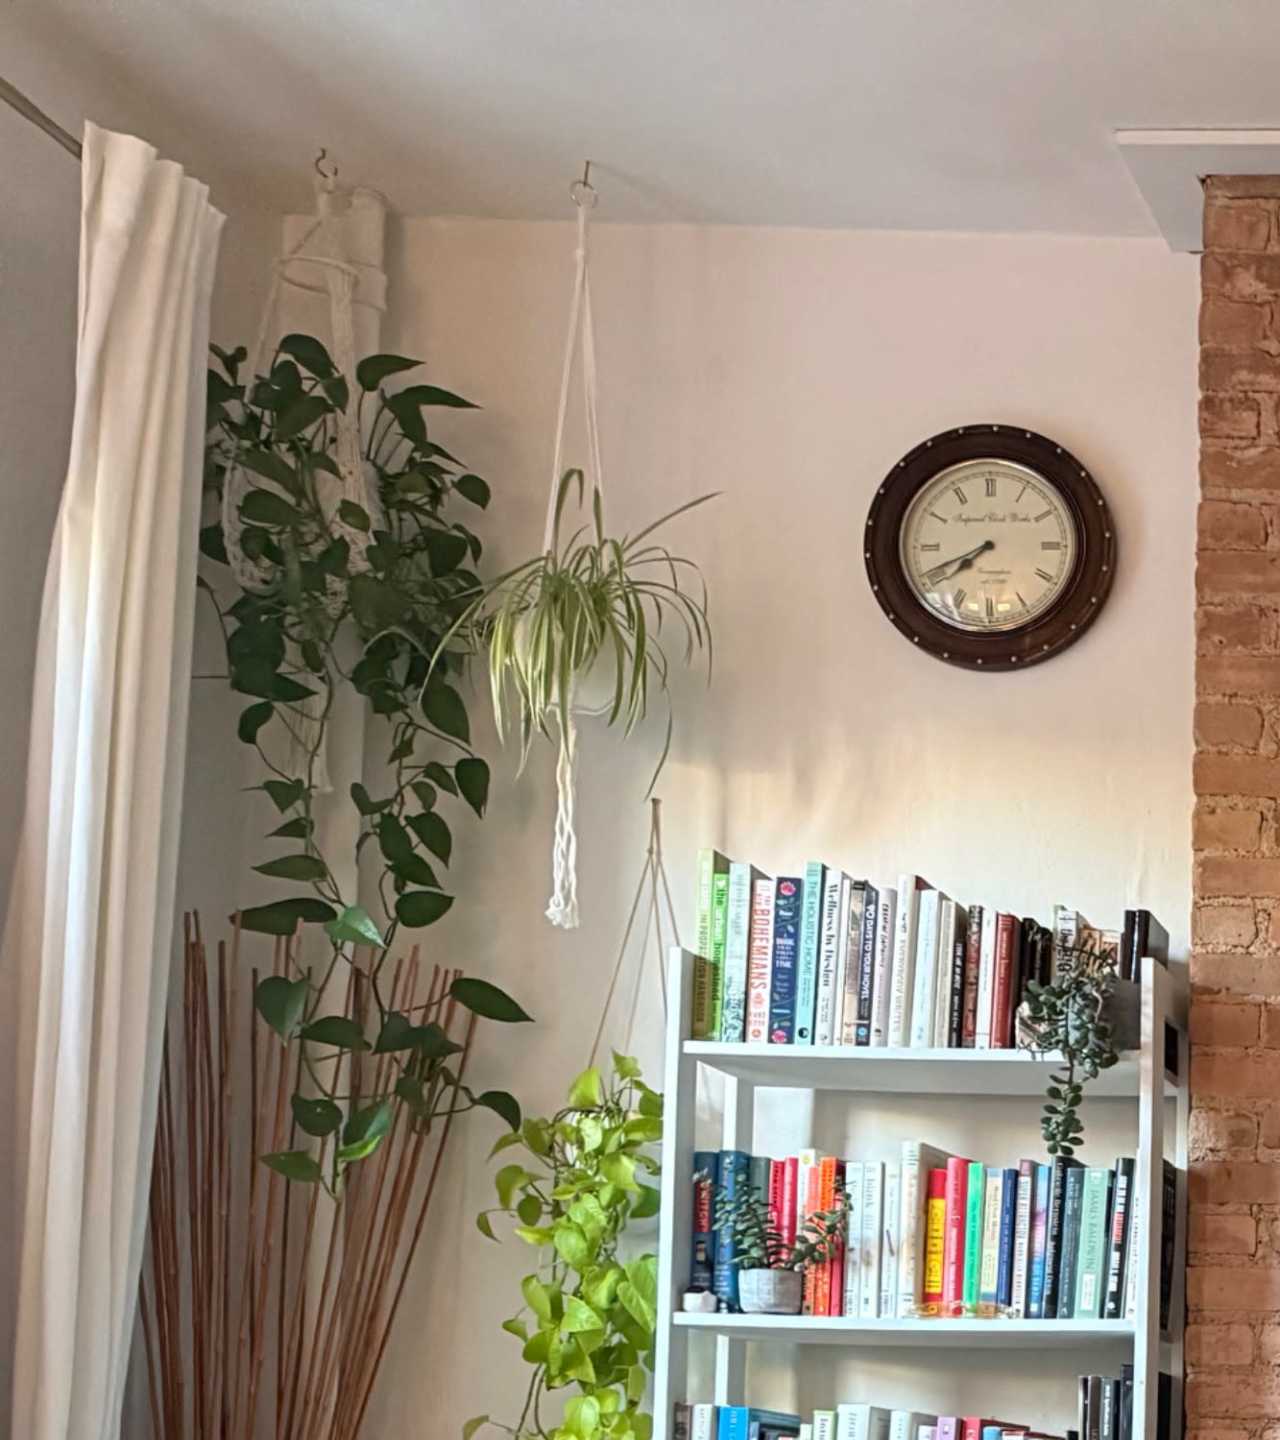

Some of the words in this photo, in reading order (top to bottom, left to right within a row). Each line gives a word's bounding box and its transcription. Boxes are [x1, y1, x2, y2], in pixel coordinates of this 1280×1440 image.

[826, 884, 838, 931] Wellness
[866, 904, 874, 918] 90
[865, 919, 873, 938] DAYS
[751, 908, 769, 989] BOHEMIANS
[864, 940, 872, 950] TO
[822, 950, 836, 986] Design
[863, 952, 871, 972] YOUR
